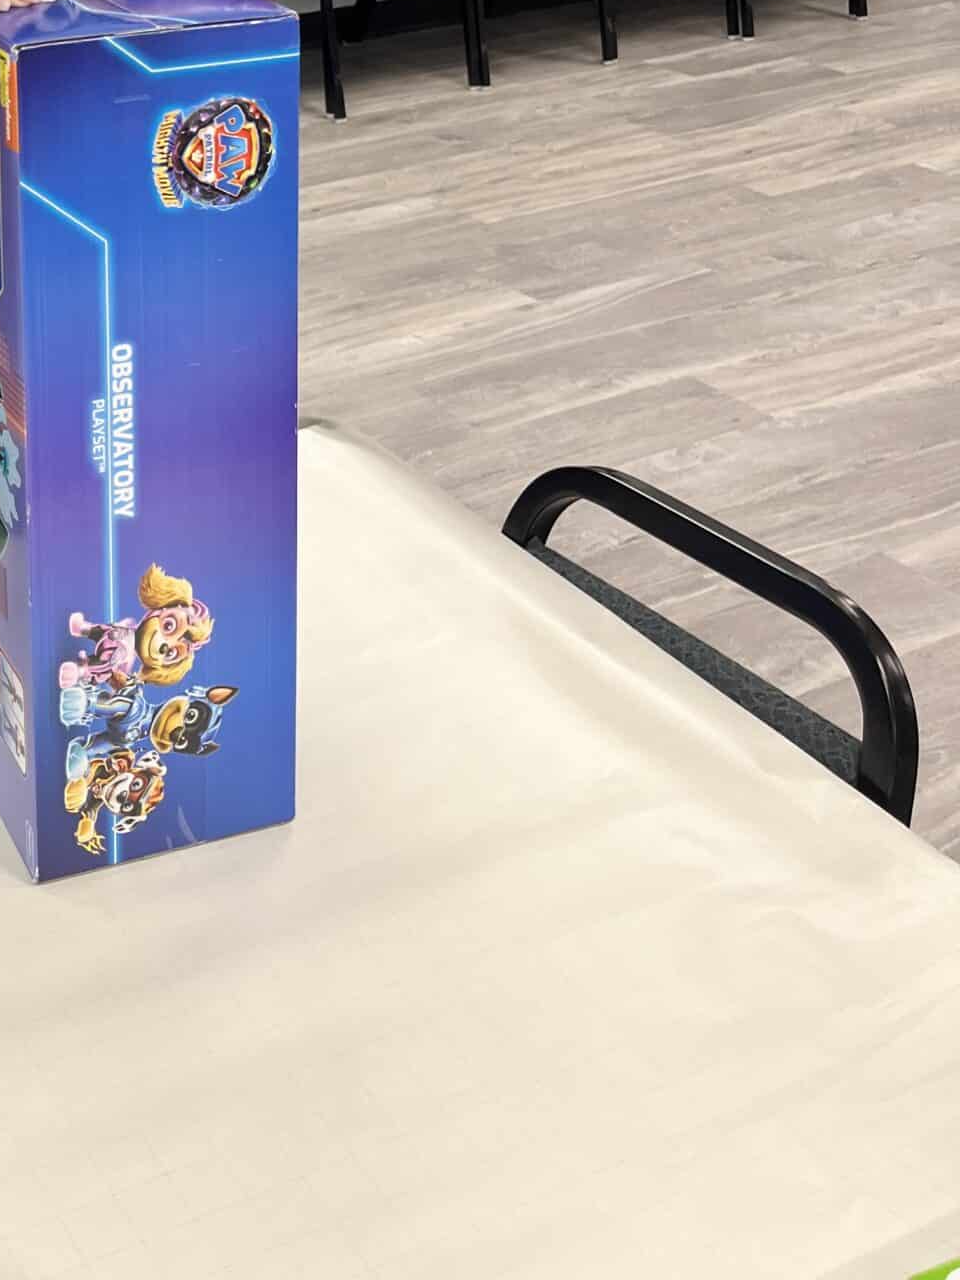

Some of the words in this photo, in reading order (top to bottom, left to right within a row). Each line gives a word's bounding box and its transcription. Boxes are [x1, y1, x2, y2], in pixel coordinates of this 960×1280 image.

[152, 110, 179, 164] MIGHTY
[203, 133, 213, 178] PATROL
[214, 104, 246, 197] PAW
[152, 166, 181, 208] MOVIE
[111, 343, 134, 518] OBSERVATORY
